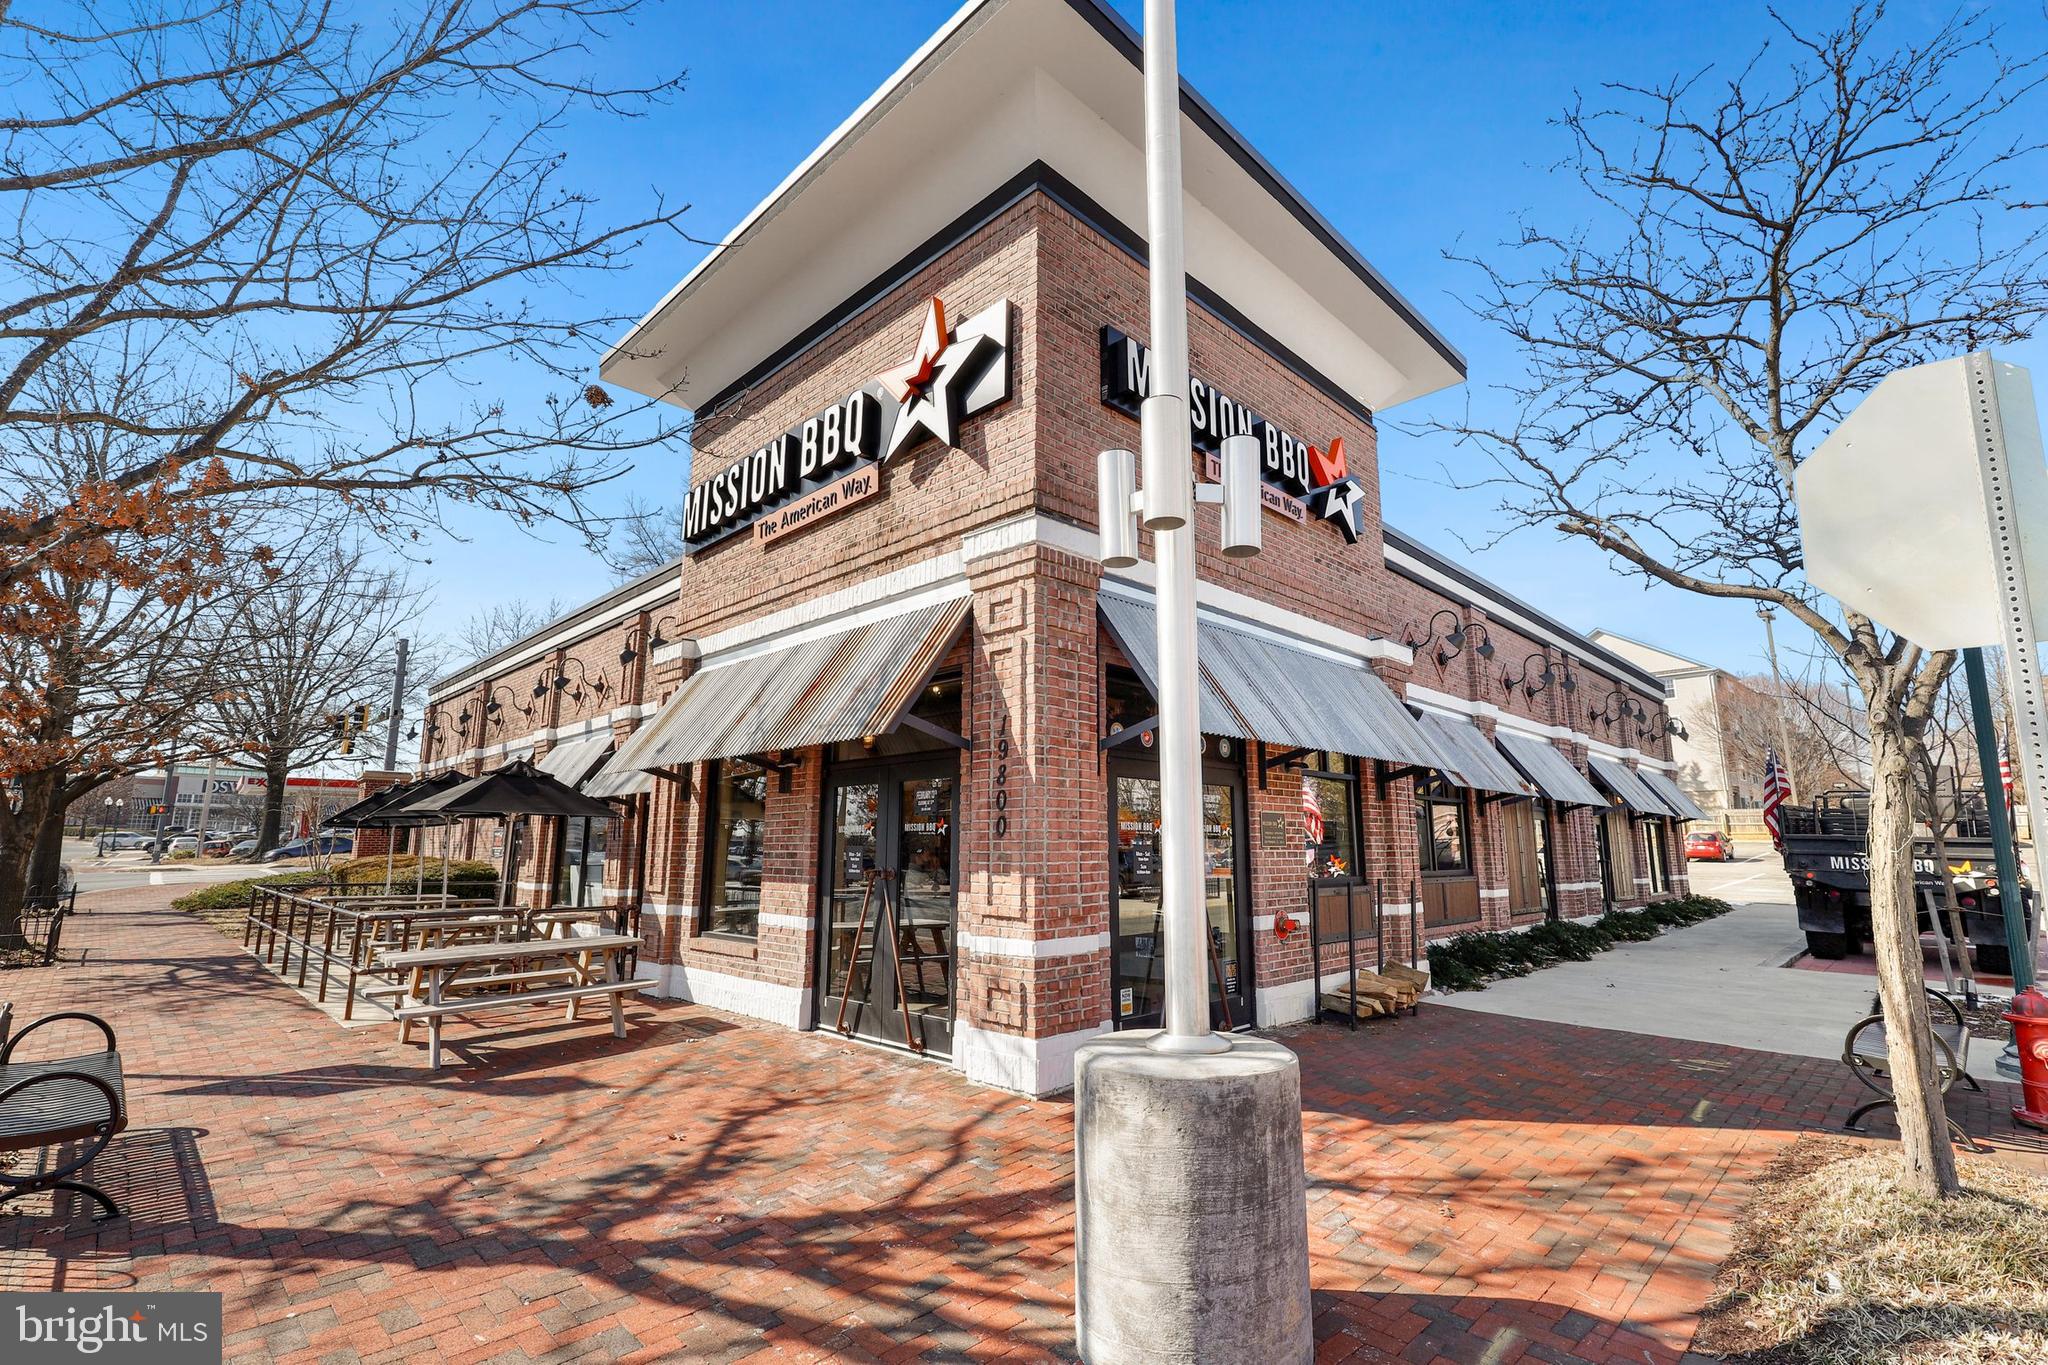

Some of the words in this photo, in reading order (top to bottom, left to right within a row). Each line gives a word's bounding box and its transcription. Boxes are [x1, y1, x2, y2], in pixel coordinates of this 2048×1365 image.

[683, 434, 789, 539] MISSION
[800, 389, 864, 478] BBQ
[1126, 336, 1252, 439] MSION
[1265, 420, 1310, 494] BBQ
[758, 521, 777, 539] The
[780, 491, 838, 530] American
[842, 475, 872, 500] Way.
[996, 714, 1009, 838] 19800
[1914, 859, 1935, 874] BQ
